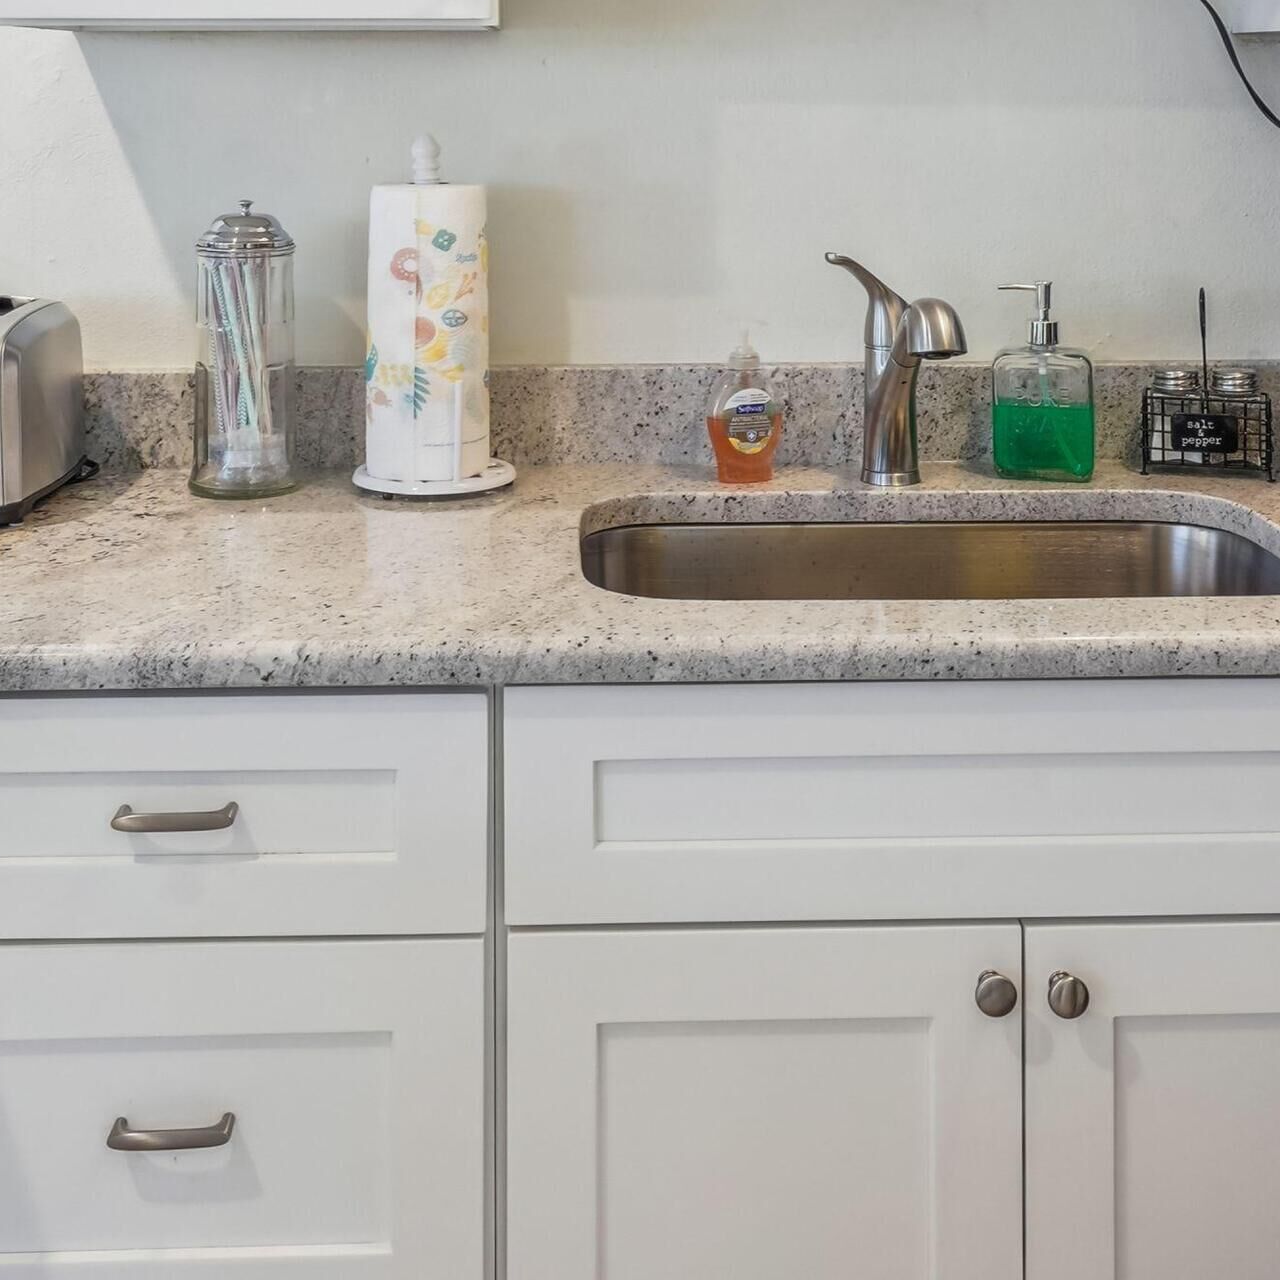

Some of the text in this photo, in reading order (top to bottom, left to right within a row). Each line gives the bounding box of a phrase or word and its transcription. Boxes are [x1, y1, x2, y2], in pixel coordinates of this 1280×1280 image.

[1186, 419, 1215, 430] salt
[1197, 428, 1205, 438] &
[1181, 437, 1223, 448] pepper
